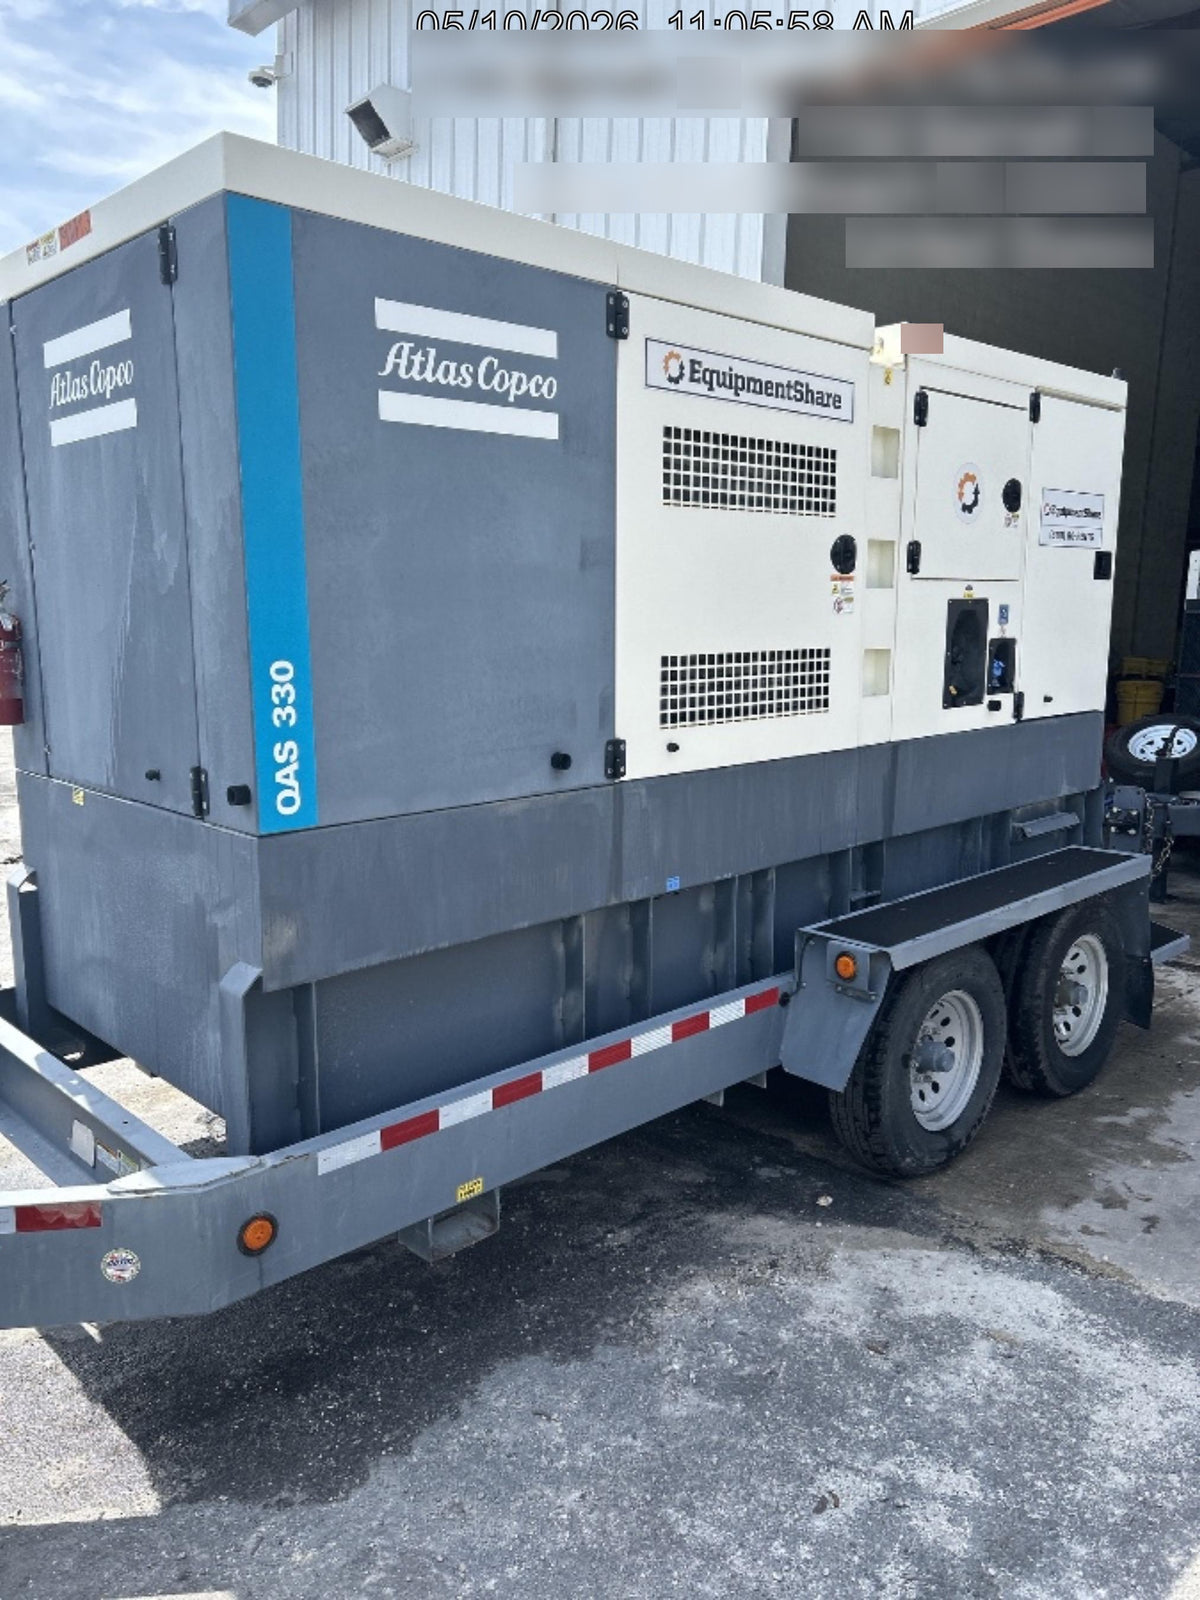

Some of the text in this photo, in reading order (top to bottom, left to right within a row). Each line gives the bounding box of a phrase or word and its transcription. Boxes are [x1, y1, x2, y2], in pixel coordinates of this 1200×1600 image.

[48, 360, 134, 410] Atlas Copco
[377, 341, 558, 403] Atlas Copco
[688, 358, 843, 410] EquipmentShare
[269, 660, 301, 816] QAS 330
